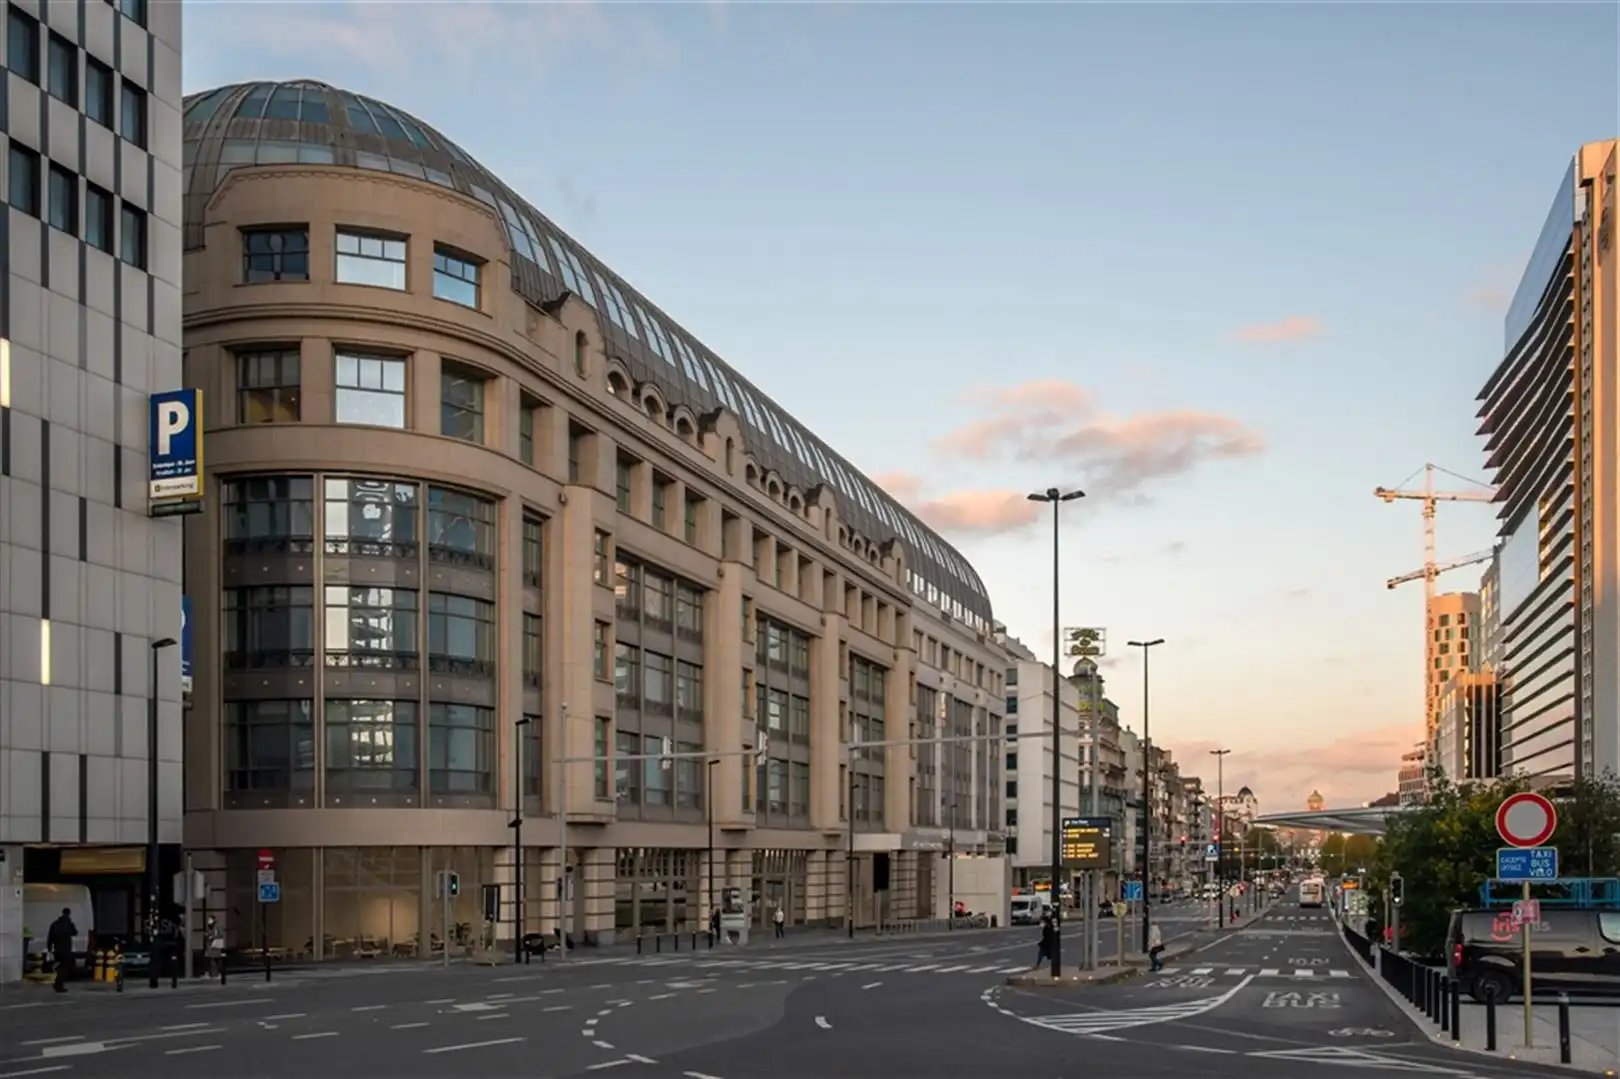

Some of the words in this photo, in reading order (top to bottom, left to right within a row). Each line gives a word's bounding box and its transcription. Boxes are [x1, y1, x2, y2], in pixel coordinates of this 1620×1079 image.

[158, 400, 189, 455] P
[1530, 850, 1552, 858] TAXI
[1530, 859, 1551, 868] BUS
